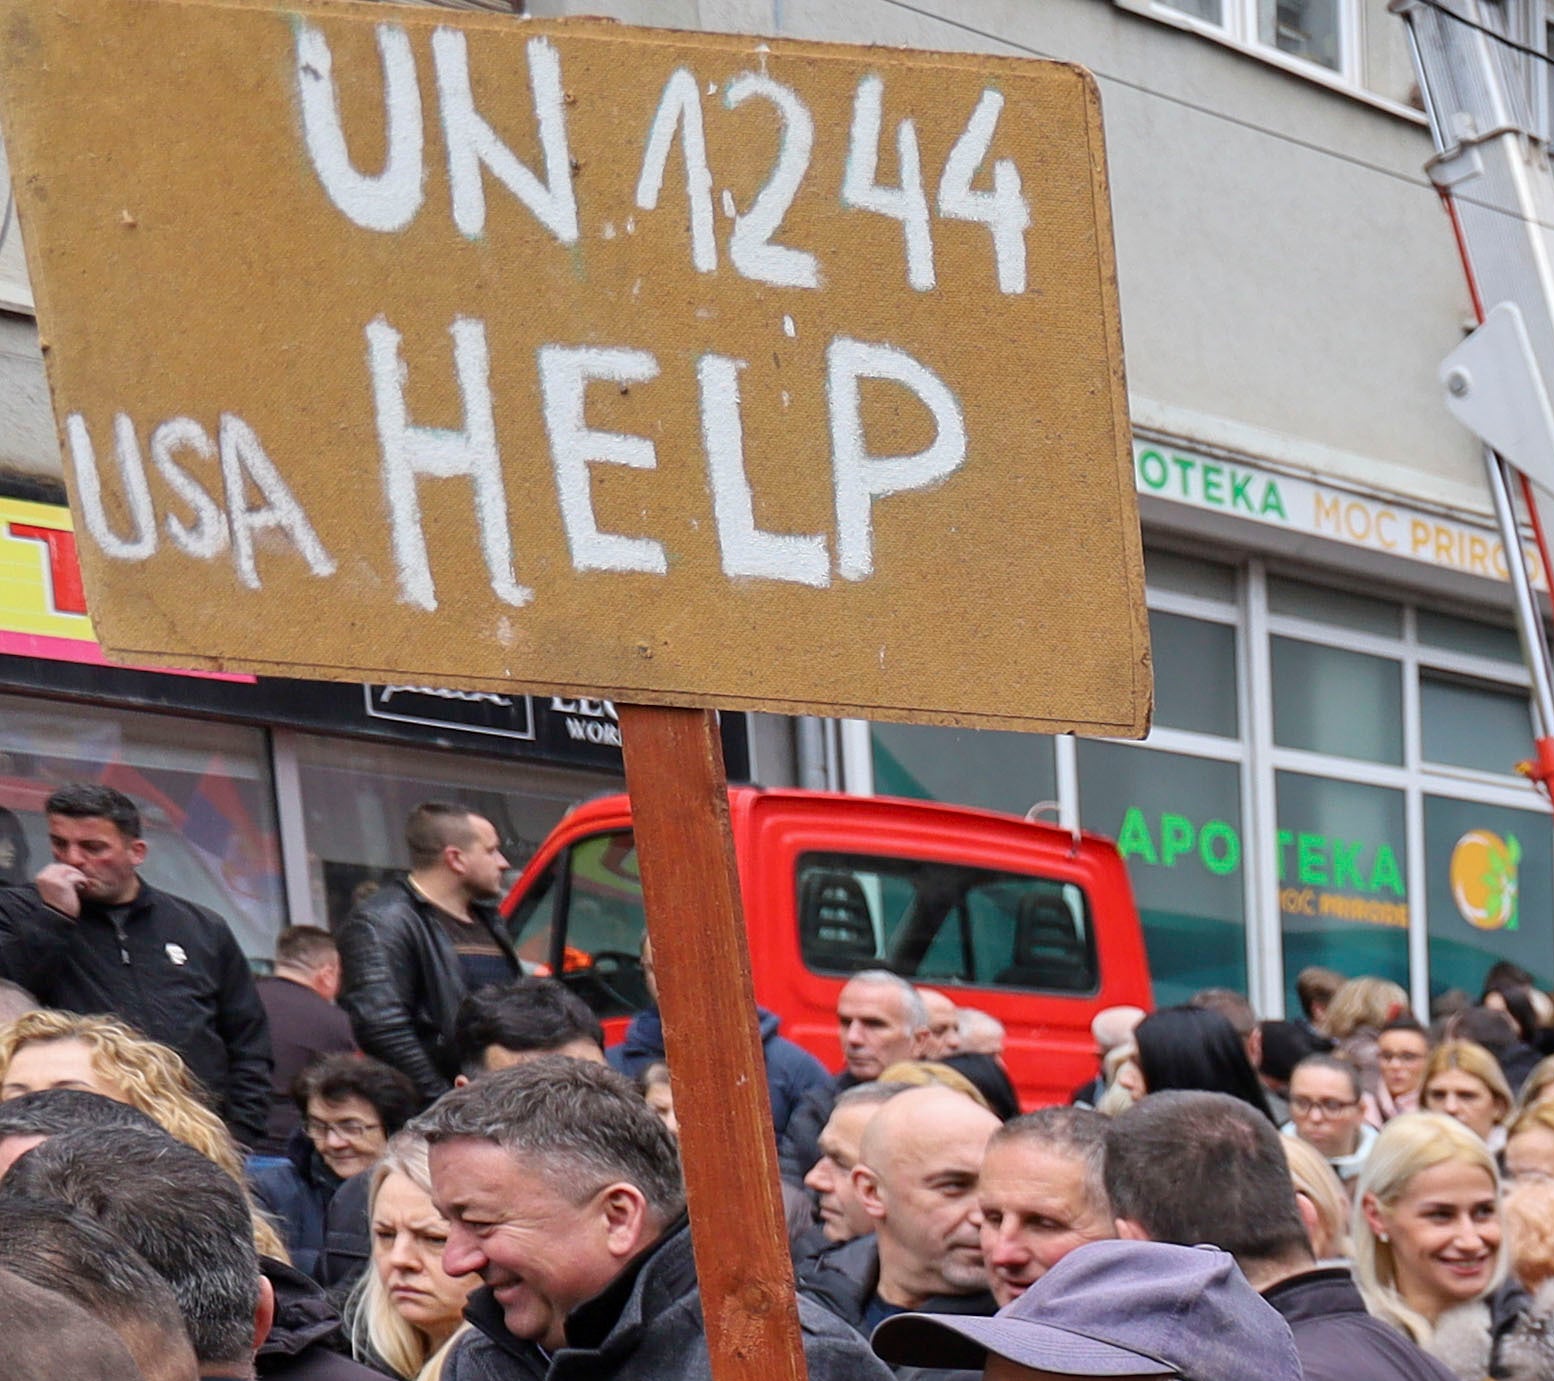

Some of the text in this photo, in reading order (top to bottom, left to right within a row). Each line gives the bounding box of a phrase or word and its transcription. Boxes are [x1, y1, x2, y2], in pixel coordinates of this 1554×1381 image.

[297, 21, 1031, 295] UN 1244
[67, 315, 967, 611] USA HELP
